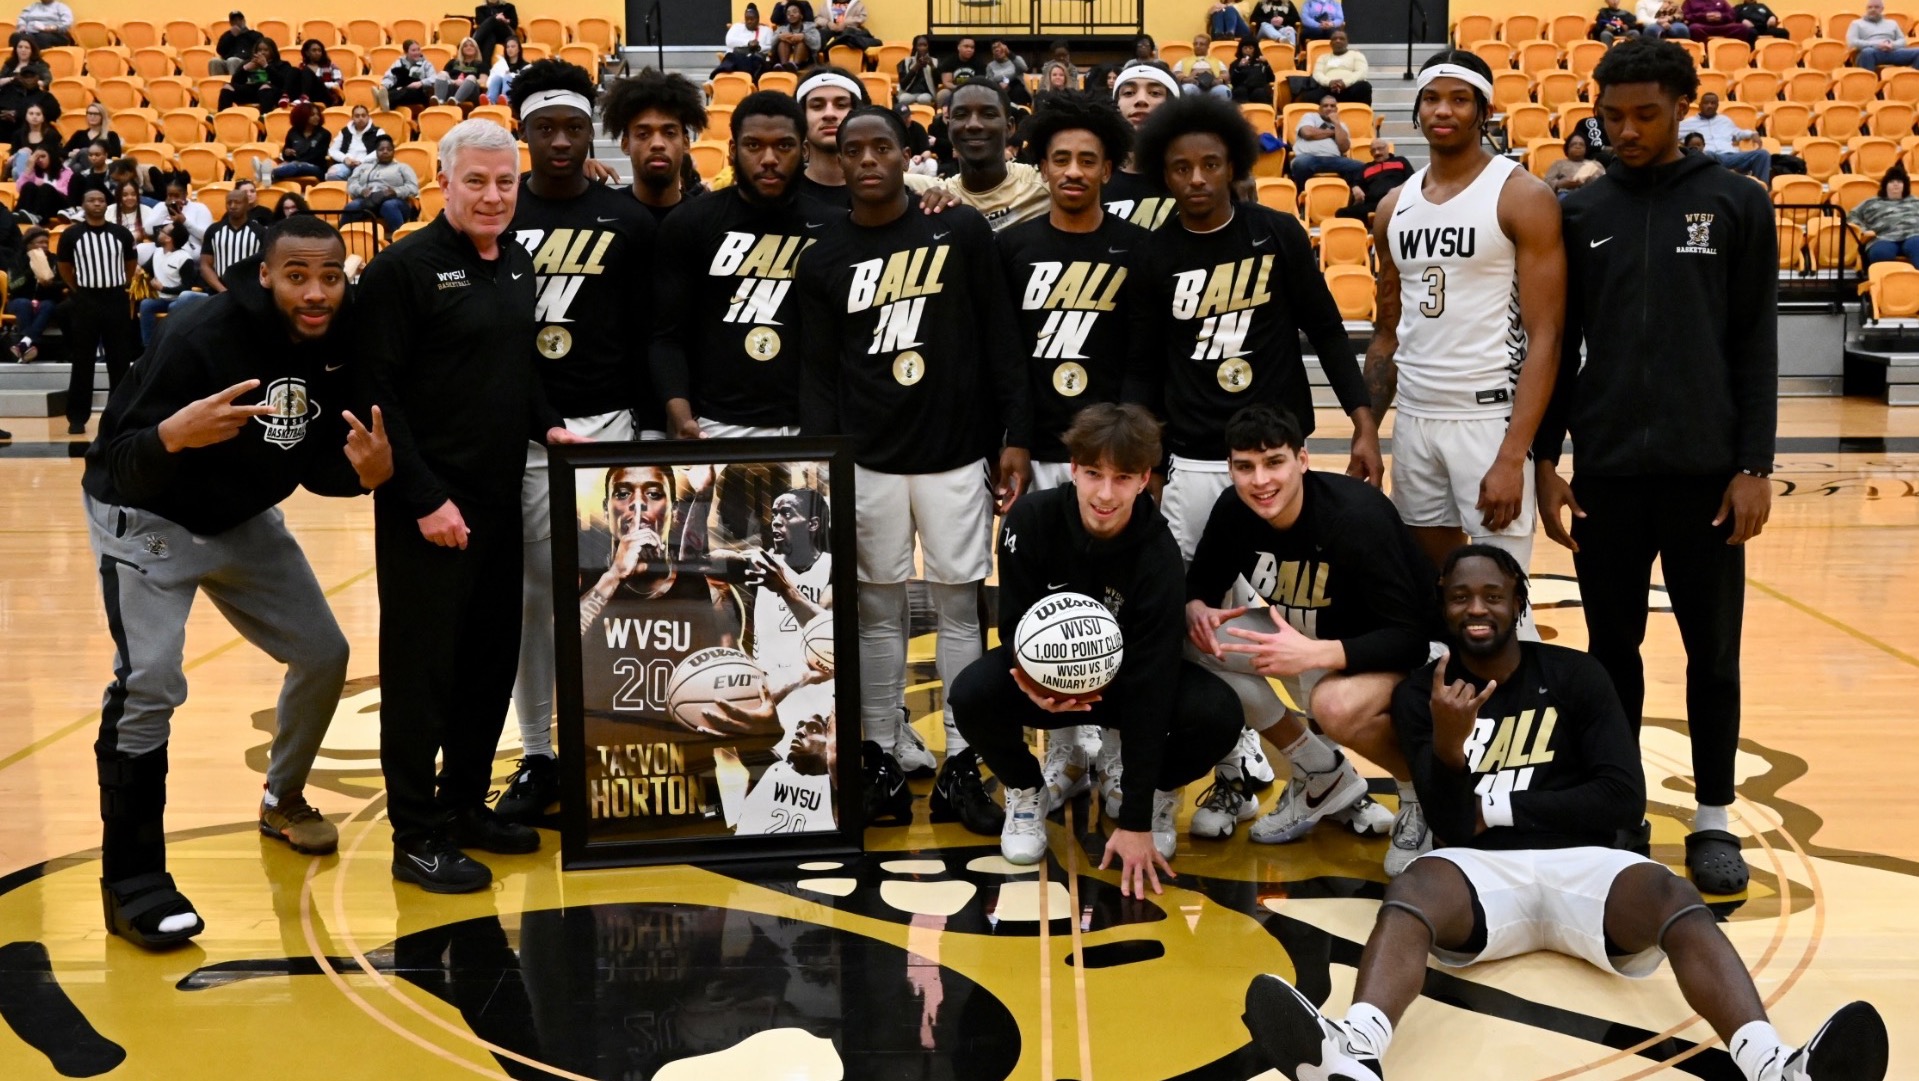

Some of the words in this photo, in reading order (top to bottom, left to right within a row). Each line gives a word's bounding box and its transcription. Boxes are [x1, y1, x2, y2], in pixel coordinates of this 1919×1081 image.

[1685, 213, 1714, 223] WVSU
[1399, 227, 1475, 260] WVSU
[1676, 246, 1717, 255] BASKETBALL
[436, 269, 466, 281] WVSU
[847, 245, 950, 314] BALL
[1022, 261, 1128, 311] BALL
[1172, 254, 1275, 320] BALL
[1419, 265, 1445, 318] 3
[534, 275, 586, 322] N
[722, 278, 792, 325] IN
[867, 296, 927, 354] IN
[1032, 310, 1099, 359] IN
[1190, 308, 1255, 360] IN
[1250, 550, 1332, 609] BALL
[1034, 597, 1105, 621] Wilson
[603, 617, 692, 652] WVSU
[1060, 618, 1102, 640] WVSU
[1034, 643, 1067, 660] 1,000
[1071, 639, 1104, 658] POINT
[1057, 663, 1086, 677] WVSU
[1088, 660, 1103, 674] VS.
[1104, 655, 1115, 670] UC
[613, 657, 677, 711] 20
[713, 673, 751, 690] EVO
[1042, 673, 1088, 690] JANUARY
[596, 742, 685, 777] TAEVON
[590, 775, 707, 819] HORTON
[773, 781, 822, 811] WVSU
